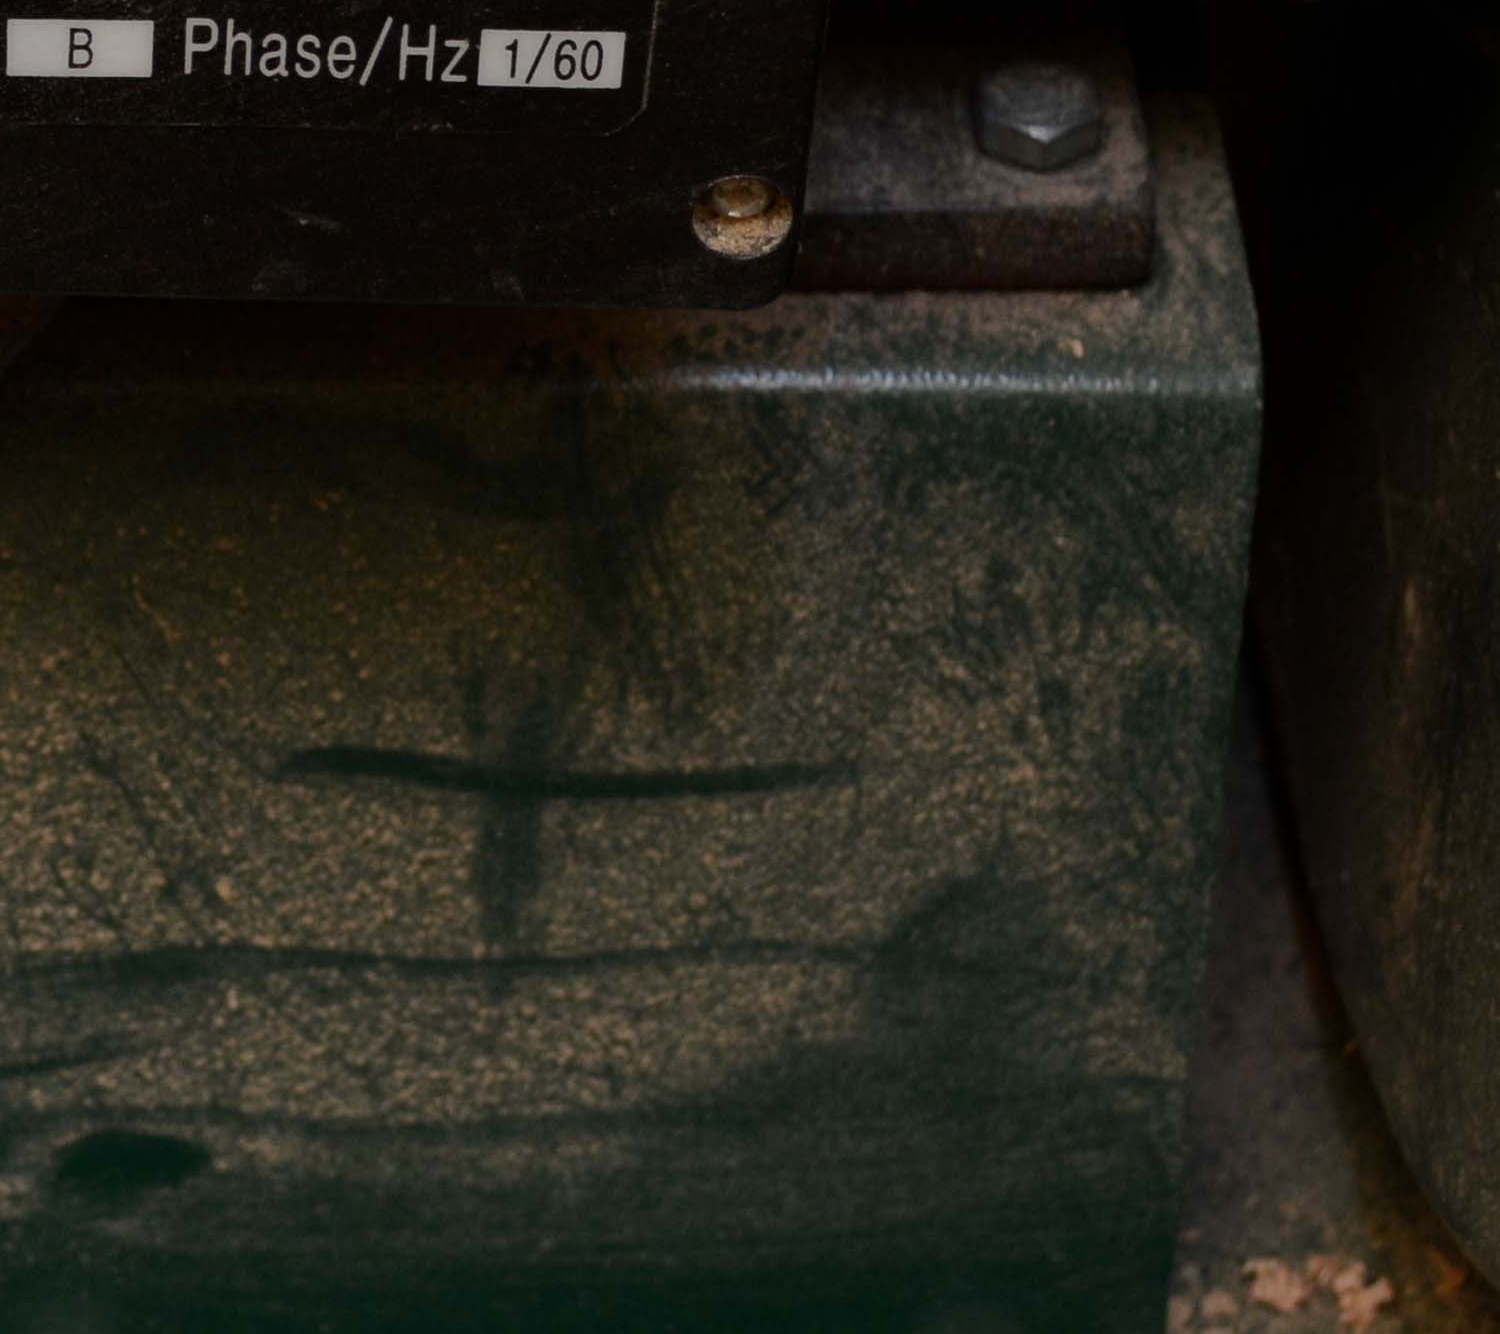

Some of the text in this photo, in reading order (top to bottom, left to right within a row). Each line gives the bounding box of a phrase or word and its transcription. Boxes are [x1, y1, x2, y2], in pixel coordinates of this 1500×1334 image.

[69, 27, 94, 69] B
[184, 16, 604, 86] Phase/Hz 1/60
